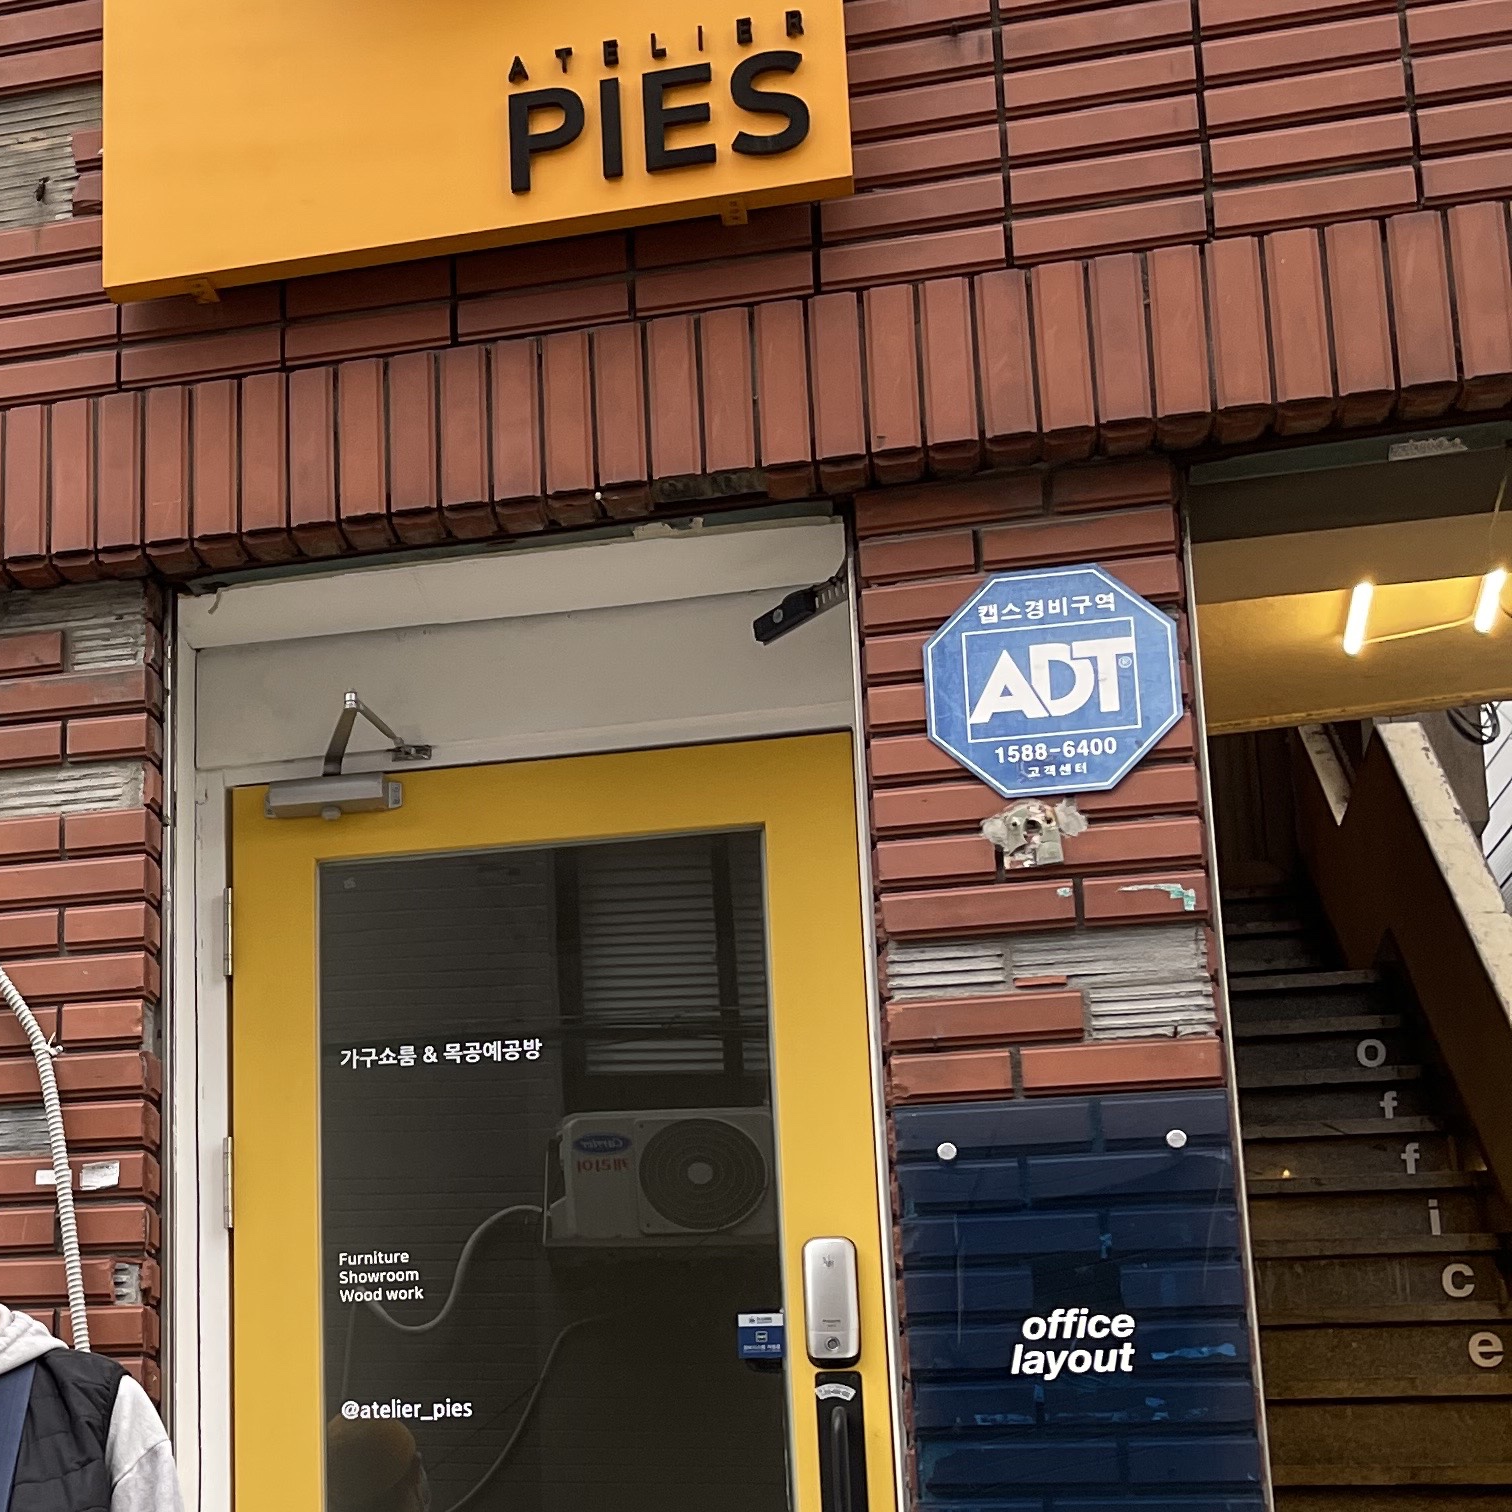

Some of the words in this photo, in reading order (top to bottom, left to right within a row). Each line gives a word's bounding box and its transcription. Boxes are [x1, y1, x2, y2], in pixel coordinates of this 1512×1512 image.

[507, 10, 806, 84] ATELIER
[507, 50, 811, 194] PIES
[977, 591, 1117, 625] 캡스경비구역
[970, 636, 1136, 725] ADT
[994, 736, 1118, 765] 1588-6400
[1027, 762, 1088, 778] 고객센터
[340, 1045, 417, 1069] 가구쇼룸
[422, 1045, 439, 1064] &
[443, 1038, 543, 1064] 목공예공방
[338, 1250, 410, 1266] Furniture
[339, 1269, 420, 1285] Showroom
[339, 1287, 383, 1303] Wood
[386, 1285, 425, 1301] work
[1022, 1307, 1136, 1341] office
[1010, 1342, 1136, 1382] layout
[341, 1397, 473, 1421] @atelier_pies
